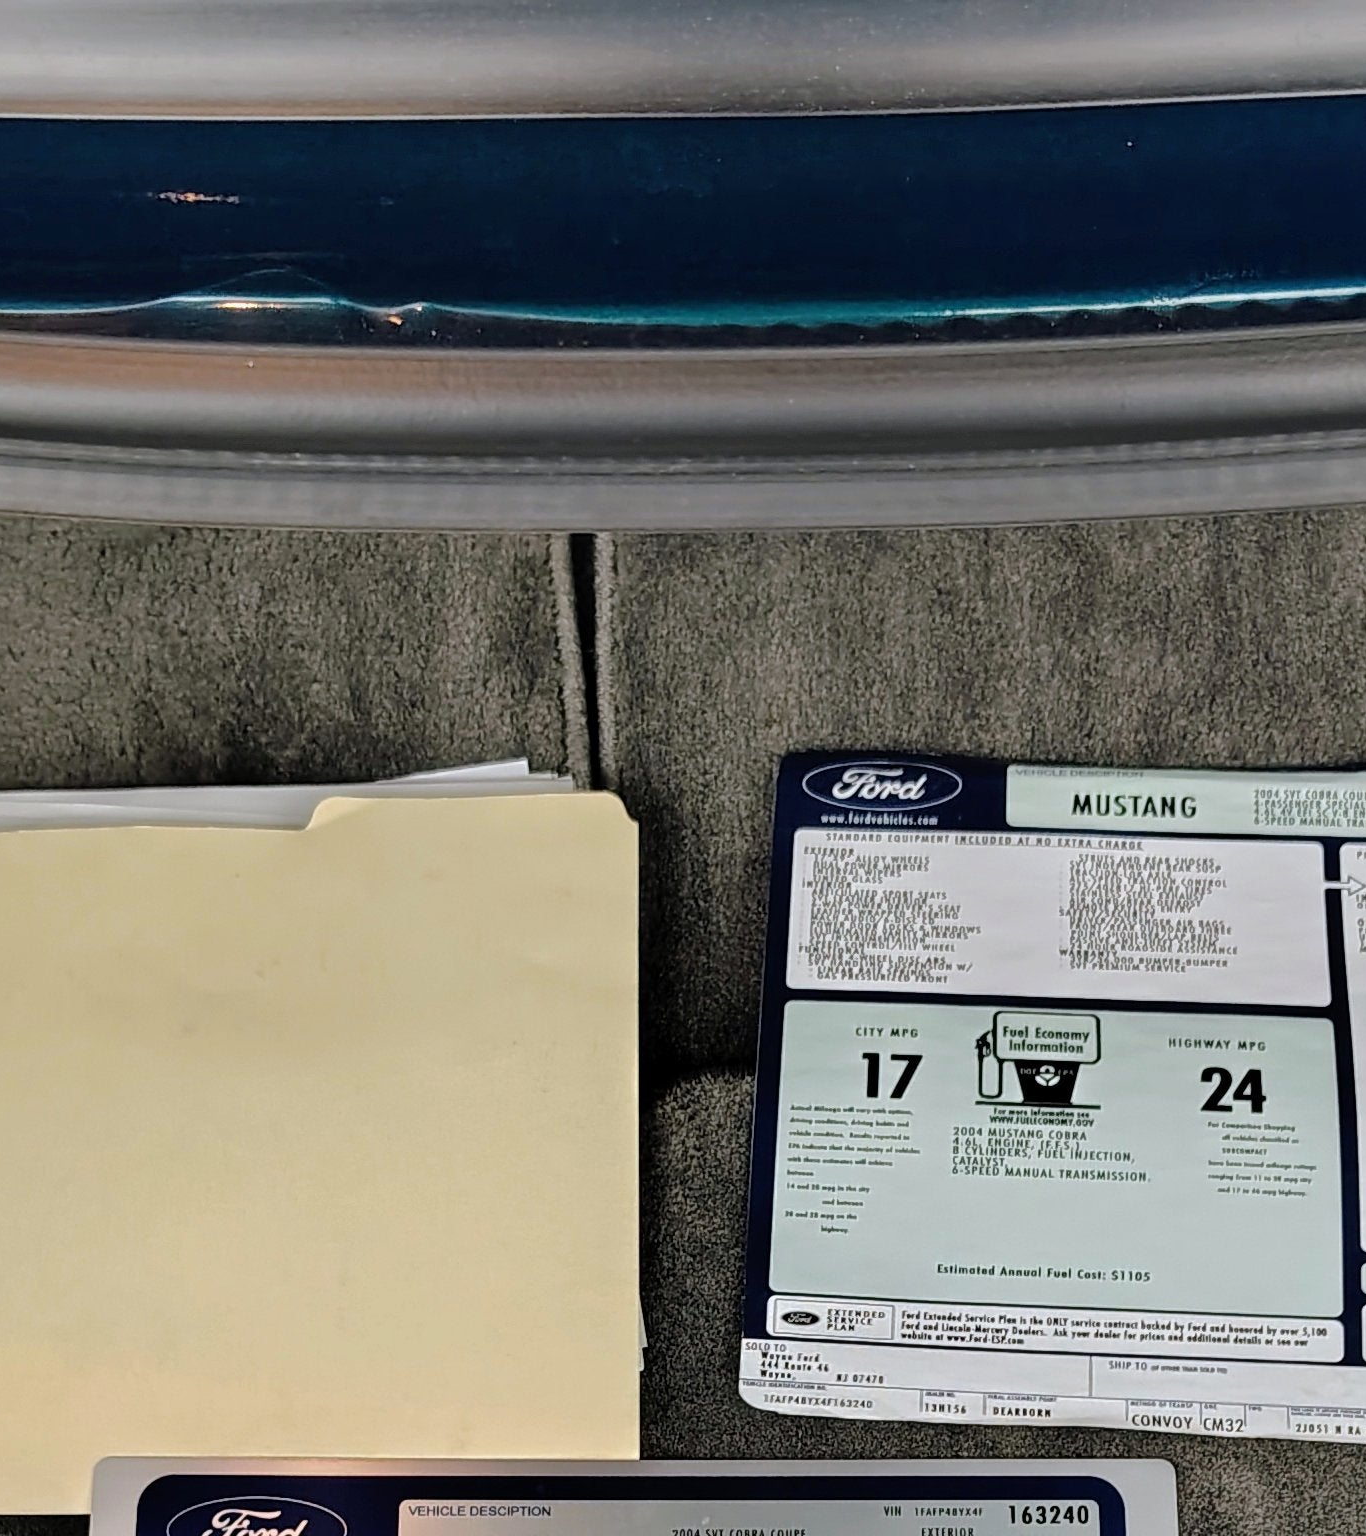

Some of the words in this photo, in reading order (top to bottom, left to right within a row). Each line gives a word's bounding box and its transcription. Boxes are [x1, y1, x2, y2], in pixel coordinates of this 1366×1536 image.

[833, 769, 928, 801] Ford
[1072, 795, 1197, 819] MUSTANG
[855, 1026, 884, 1039] CITY
[889, 1026, 918, 1039] MPG
[1002, 1026, 1028, 1041] Fuel
[1035, 1028, 1089, 1043] Economy
[1009, 1039, 1083, 1055] Information
[1168, 1037, 1231, 1051] HIGHWAY
[1237, 1040, 1266, 1052] MPG
[862, 1053, 923, 1099] 17
[1200, 1067, 1266, 1113] 24
[952, 1126, 983, 1139] 2004
[987, 1127, 1044, 1141] MUSTANG
[1047, 1130, 1087, 1142] COBRA
[951, 1165, 1000, 1178] 6-SPEED
[1004, 1166, 1053, 1180] MANUAL
[936, 1262, 996, 1277] Estimated
[999, 1265, 1042, 1279] Annual
[1046, 1266, 1072, 1280] Fuel
[992, 1406, 1052, 1419] DEARBORN
[1132, 1415, 1193, 1429] CONVOY
[1203, 1417, 1244, 1432] CM32
[407, 1505, 466, 1518] VEHICLE
[468, 1505, 551, 1518] DESCIPTION
[883, 1506, 902, 1517] VIN
[1009, 1505, 1089, 1524] 163240
